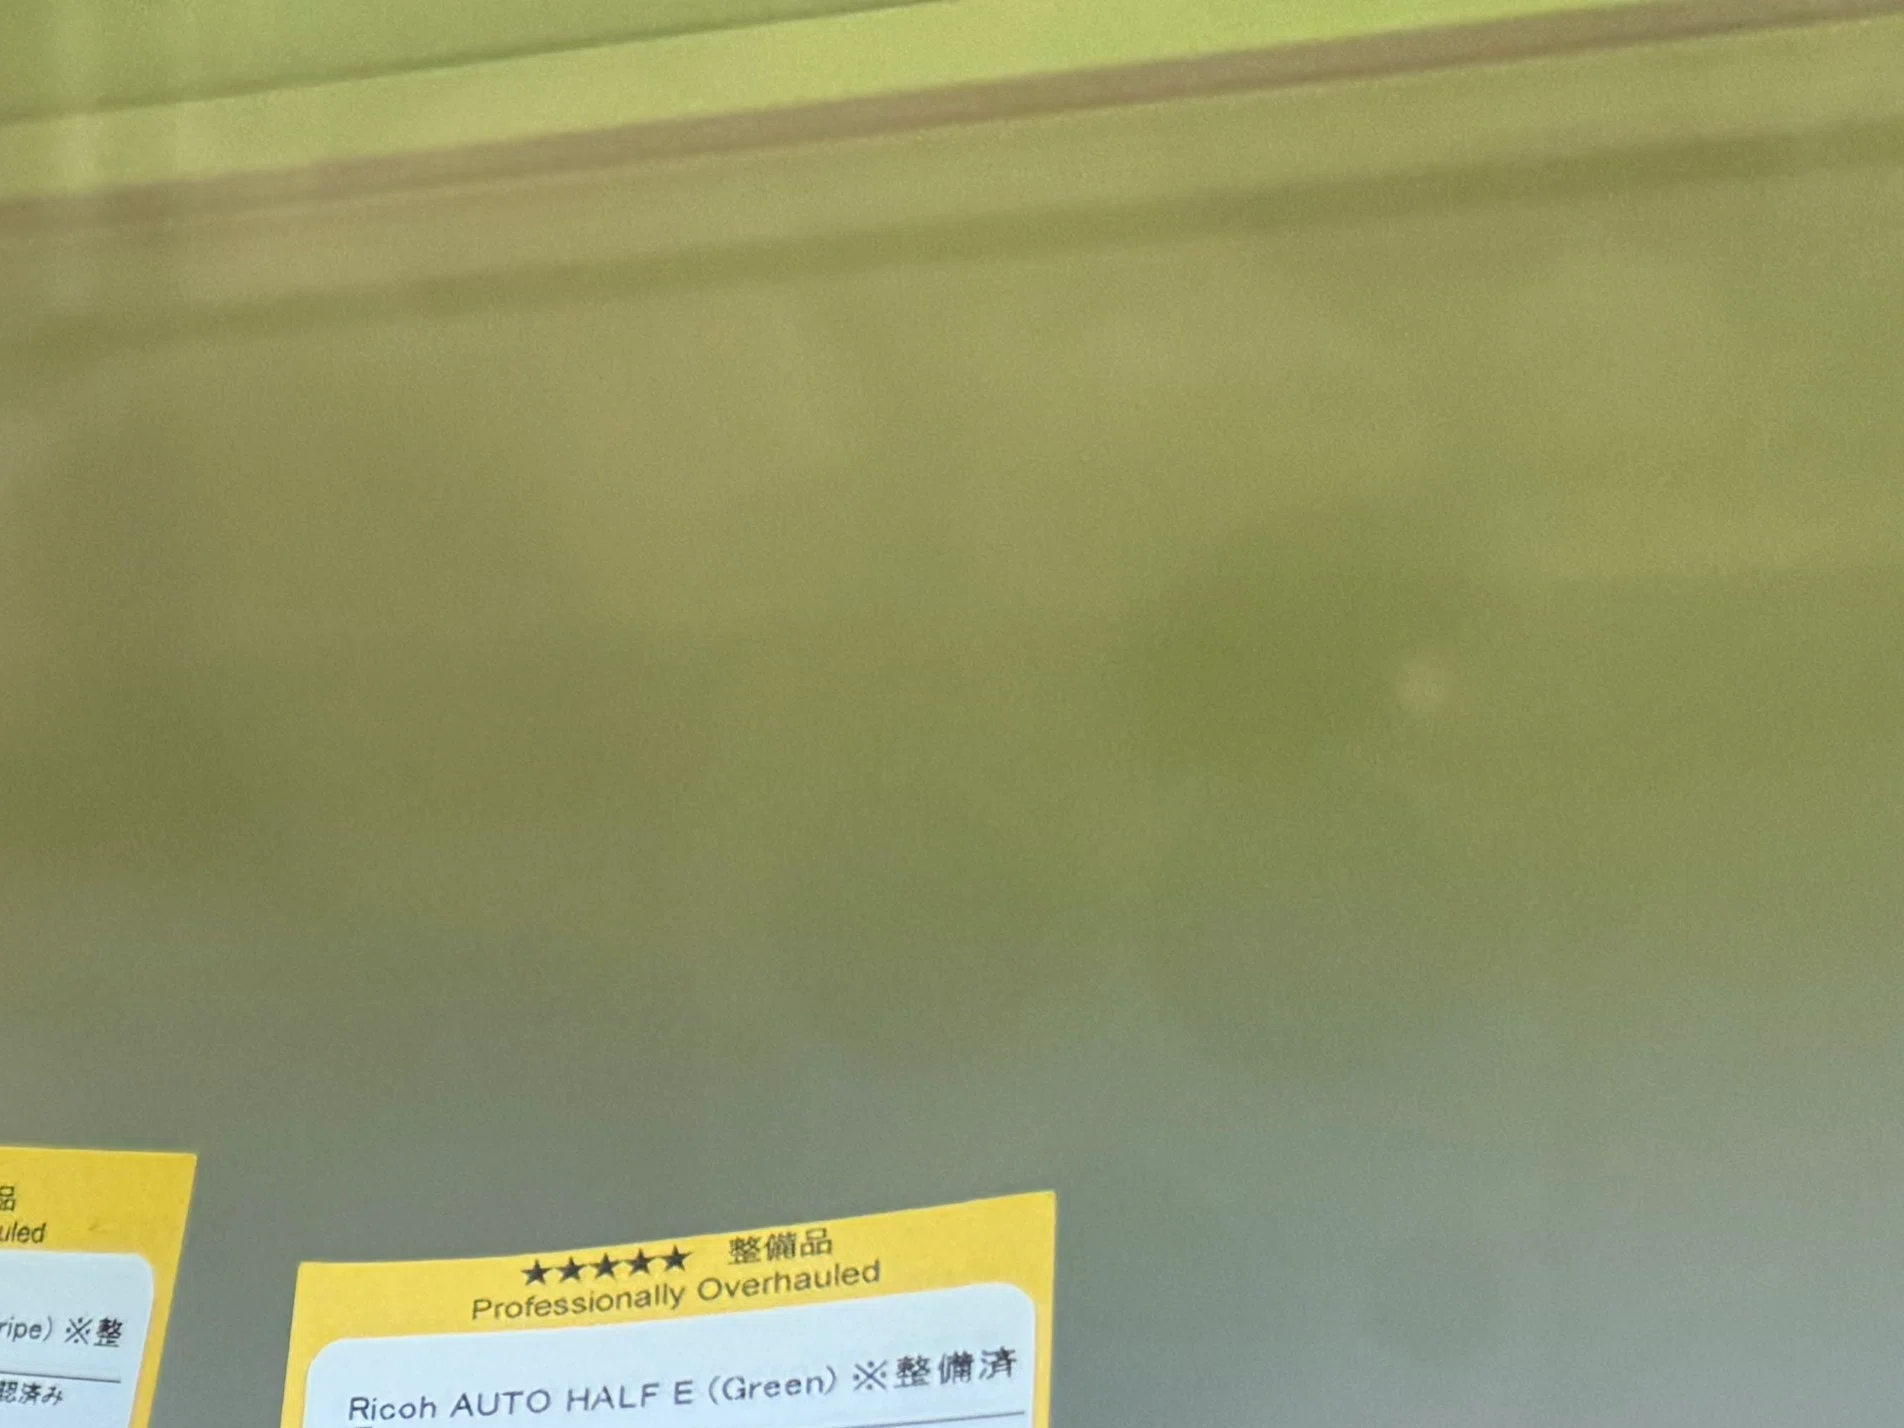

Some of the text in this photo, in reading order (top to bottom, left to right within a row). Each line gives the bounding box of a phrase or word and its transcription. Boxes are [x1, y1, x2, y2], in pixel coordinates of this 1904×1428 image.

[728, 1228, 833, 1266] 整備品
[471, 1260, 881, 1321] Professionally Overhauled
[348, 1394, 437, 1421] Ricoh
[450, 1388, 551, 1419] AUTO
[567, 1382, 662, 1411] HALF
[674, 1380, 694, 1406] E
[708, 1368, 838, 1406] (Green)
